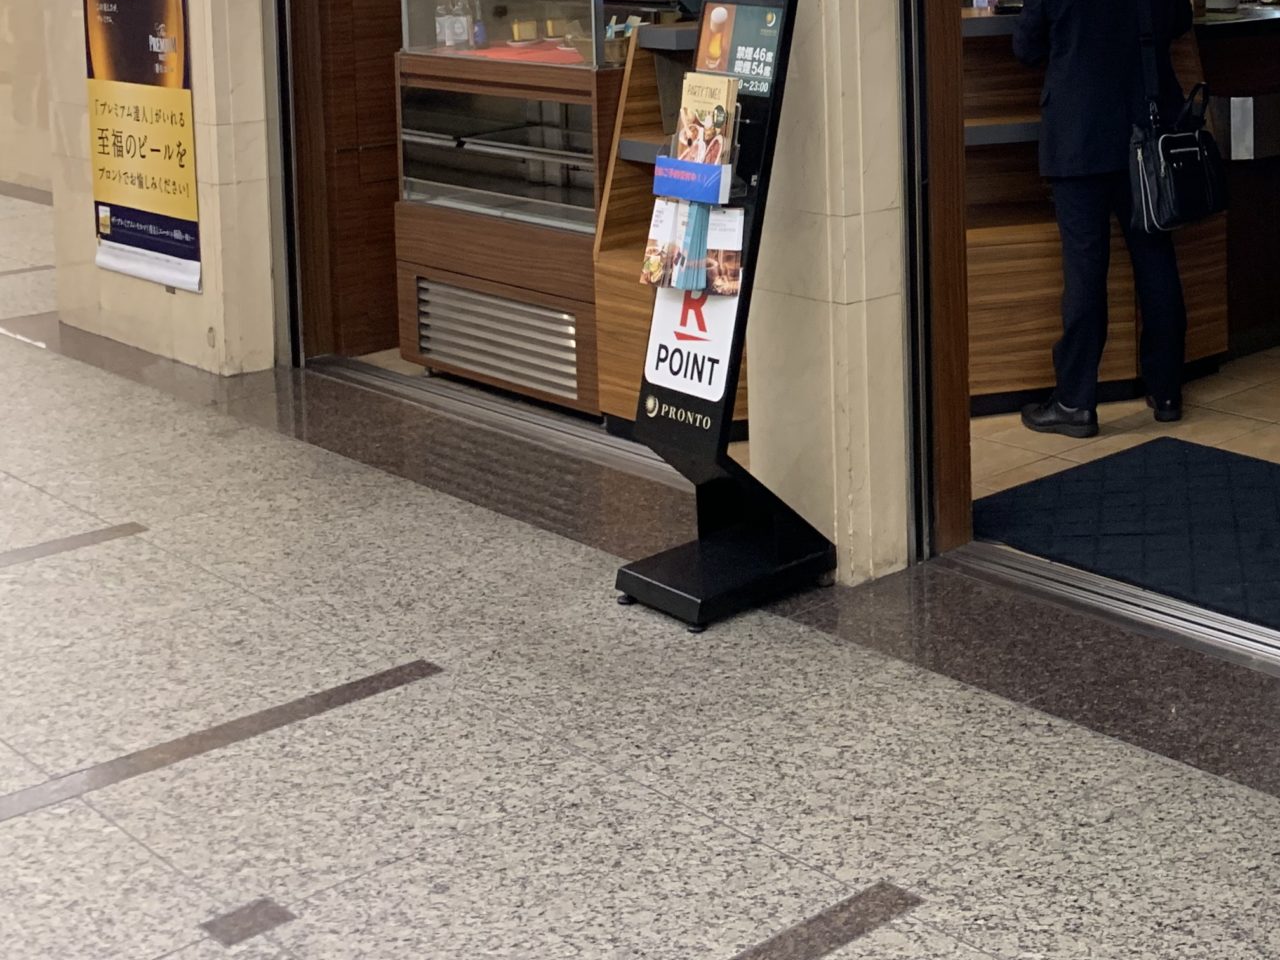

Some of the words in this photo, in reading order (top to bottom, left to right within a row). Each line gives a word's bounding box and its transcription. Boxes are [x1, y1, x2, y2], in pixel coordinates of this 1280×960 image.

[97, 127, 188, 169] 至福のビールを
[655, 343, 720, 386] POINT
[660, 403, 712, 430] PRONTO
